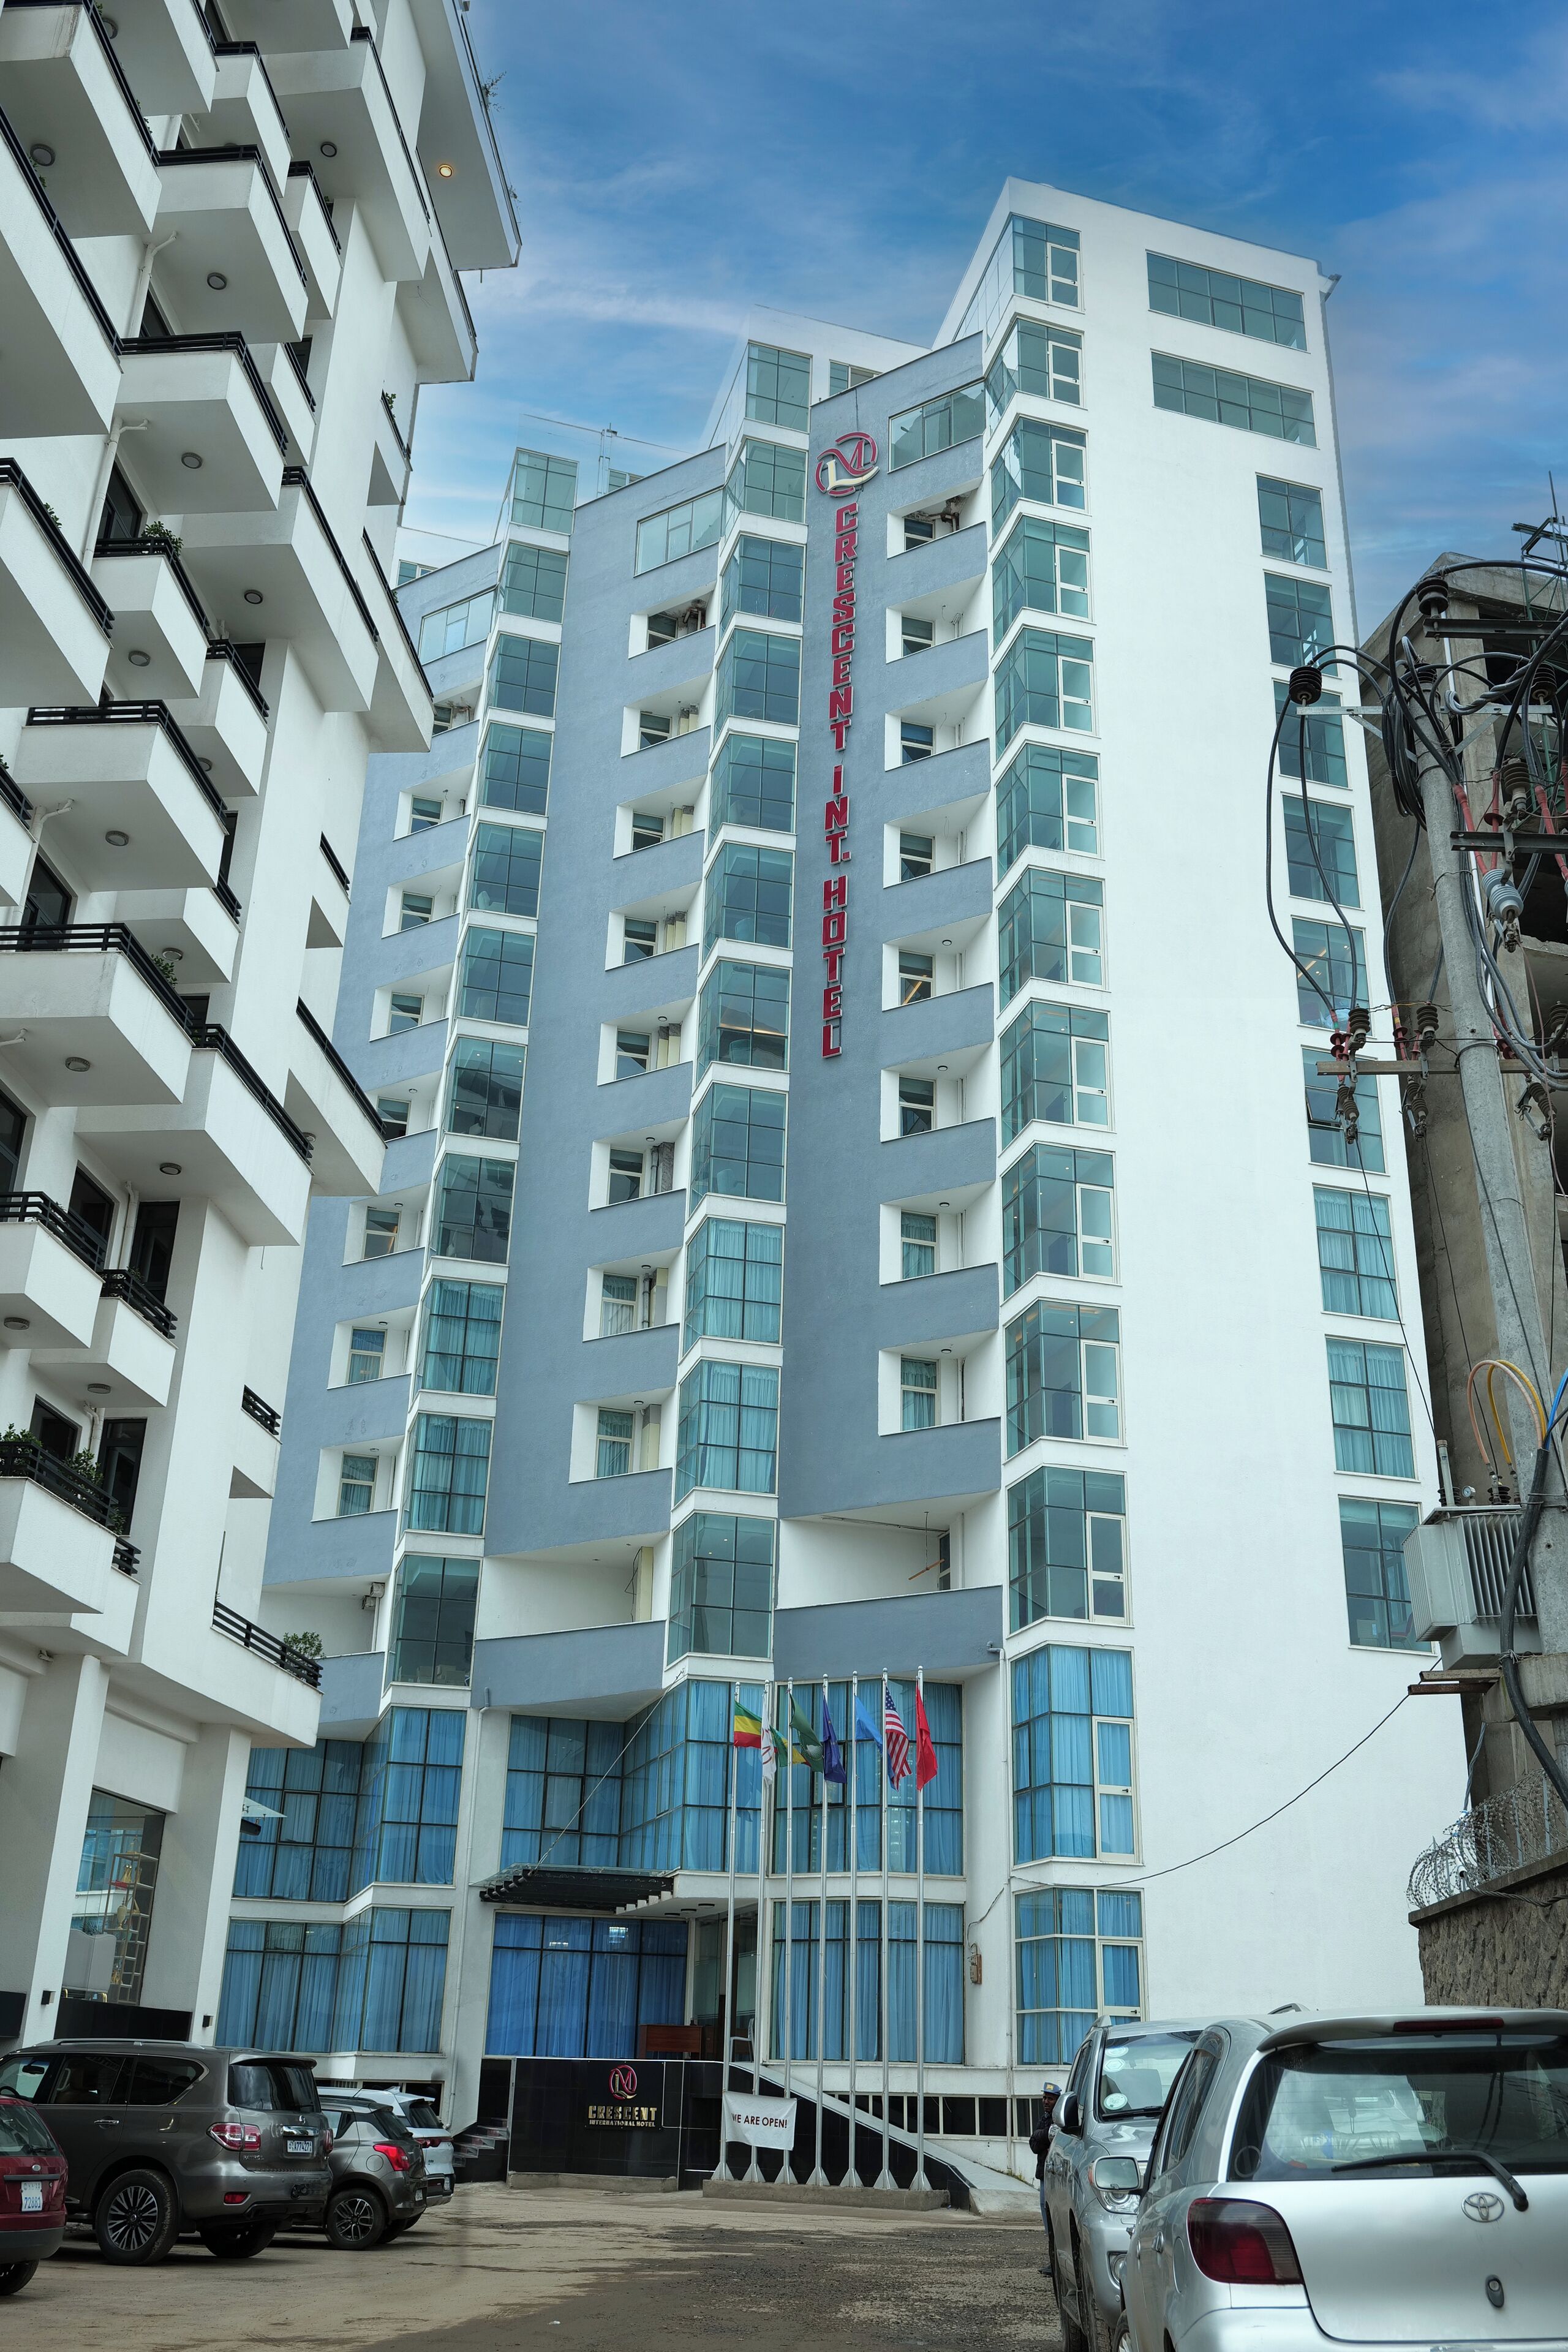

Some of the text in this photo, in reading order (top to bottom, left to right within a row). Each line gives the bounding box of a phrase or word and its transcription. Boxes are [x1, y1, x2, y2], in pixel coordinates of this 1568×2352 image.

[822, 502, 858, 1058] CRESCENT INT. HOTEL
[588, 2105, 657, 2120] CRESCENT
[731, 2113, 788, 2129] WE ARE OPEN!
[24, 2196, 41, 2209] 72881
